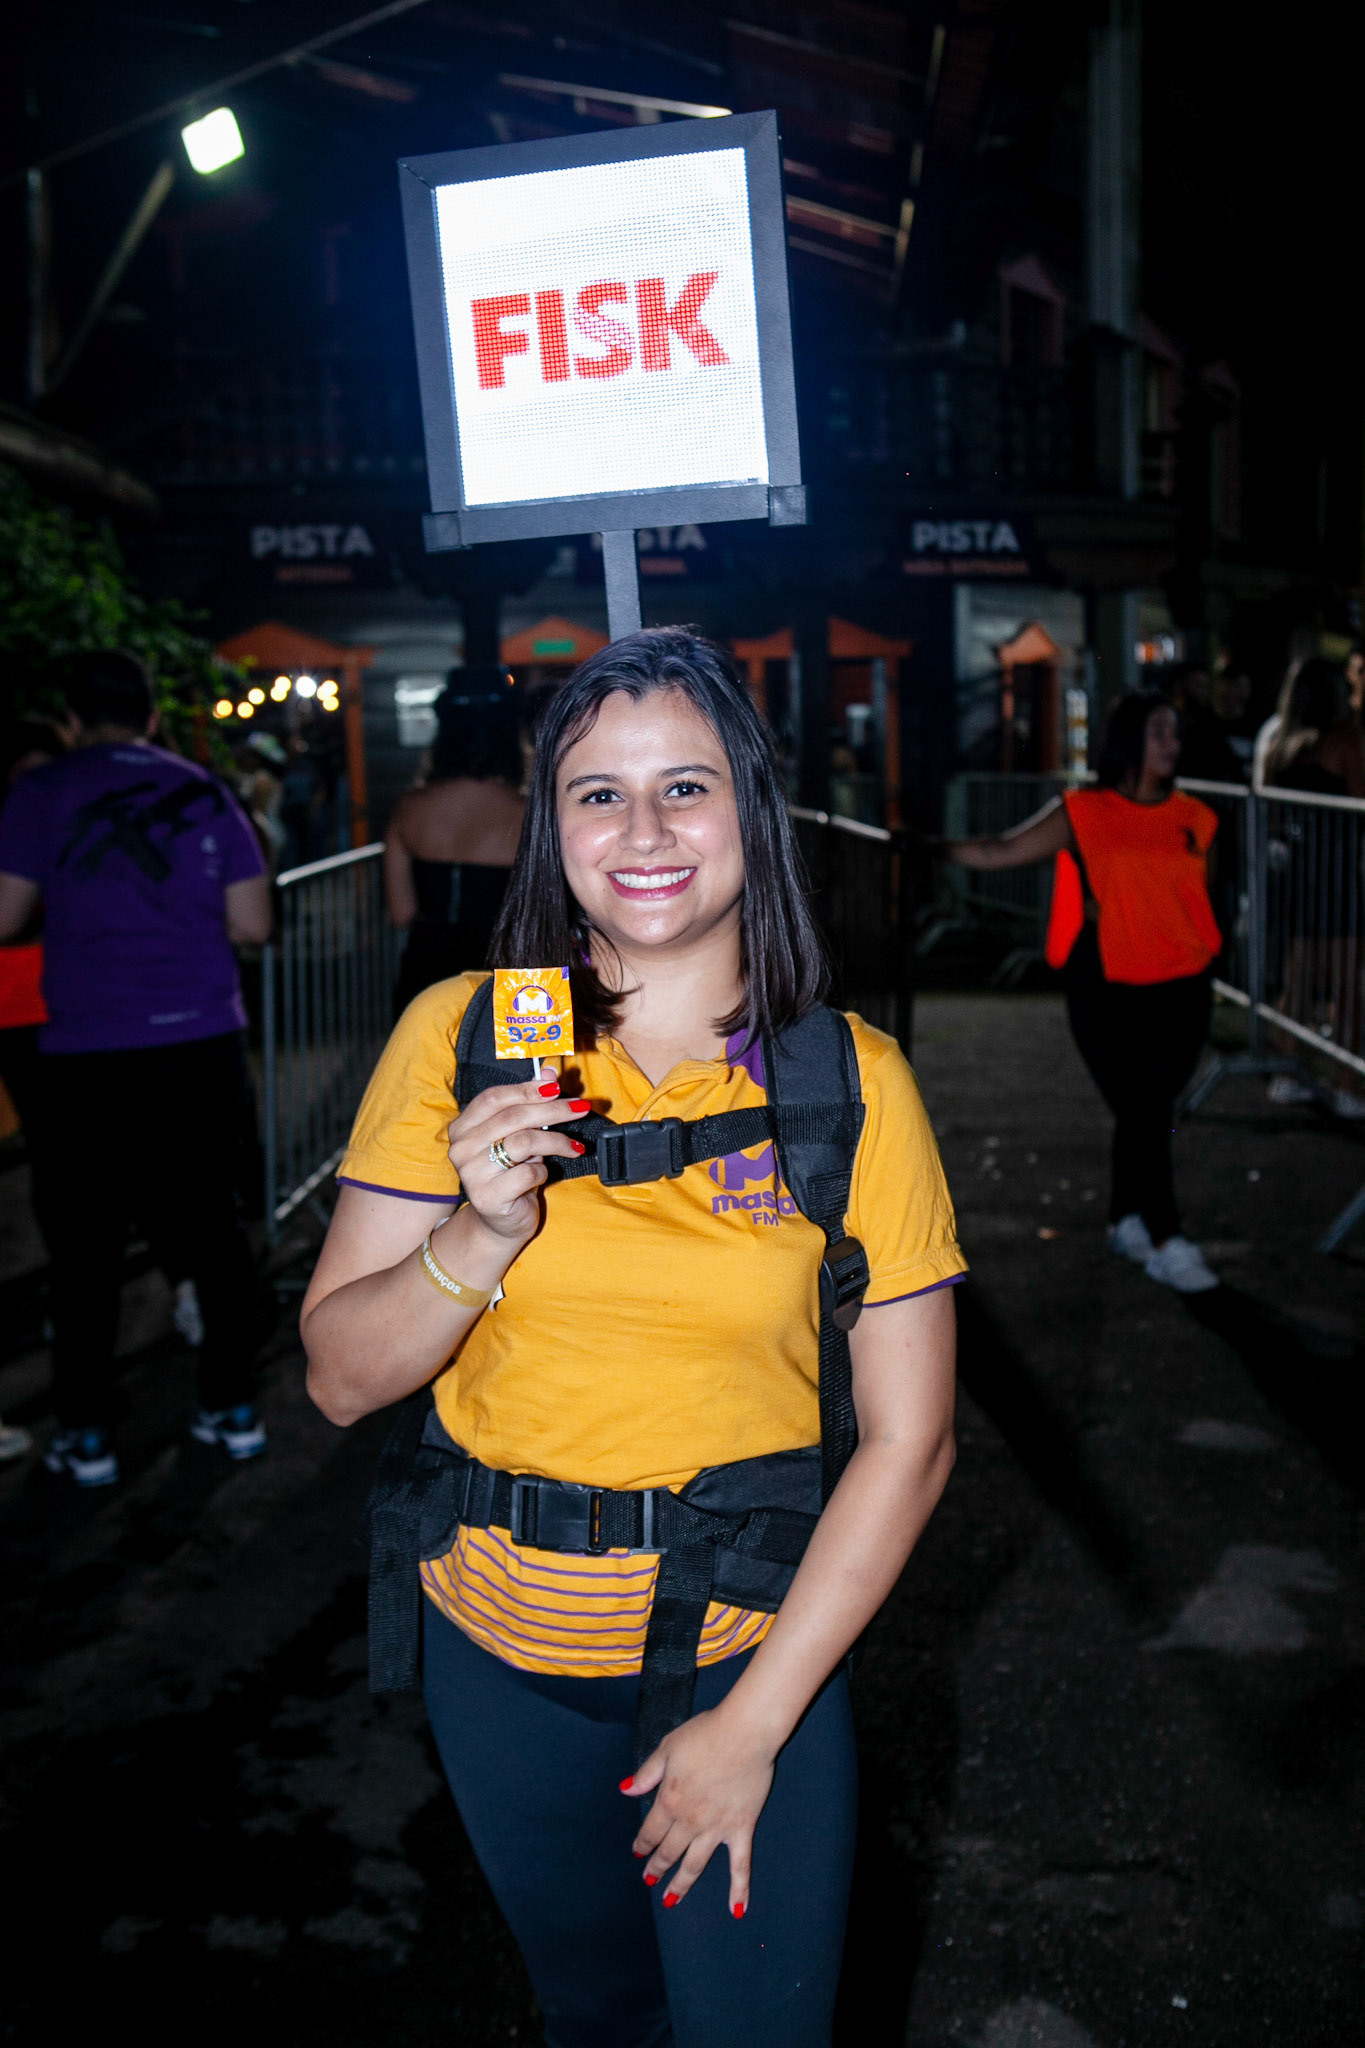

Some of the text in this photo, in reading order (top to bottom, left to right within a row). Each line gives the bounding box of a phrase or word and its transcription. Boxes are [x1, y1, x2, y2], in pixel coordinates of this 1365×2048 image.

[470, 270, 731, 391] FISK
[250, 522, 376, 559] PISTA
[911, 520, 1021, 552] PISTA
[506, 1014, 562, 1025] massa FM
[507, 1024, 562, 1044] 92.9
[711, 1190, 797, 1216] masa
[752, 1211, 780, 1228] FM
[423, 1250, 462, 1295] SERVIÇOS
